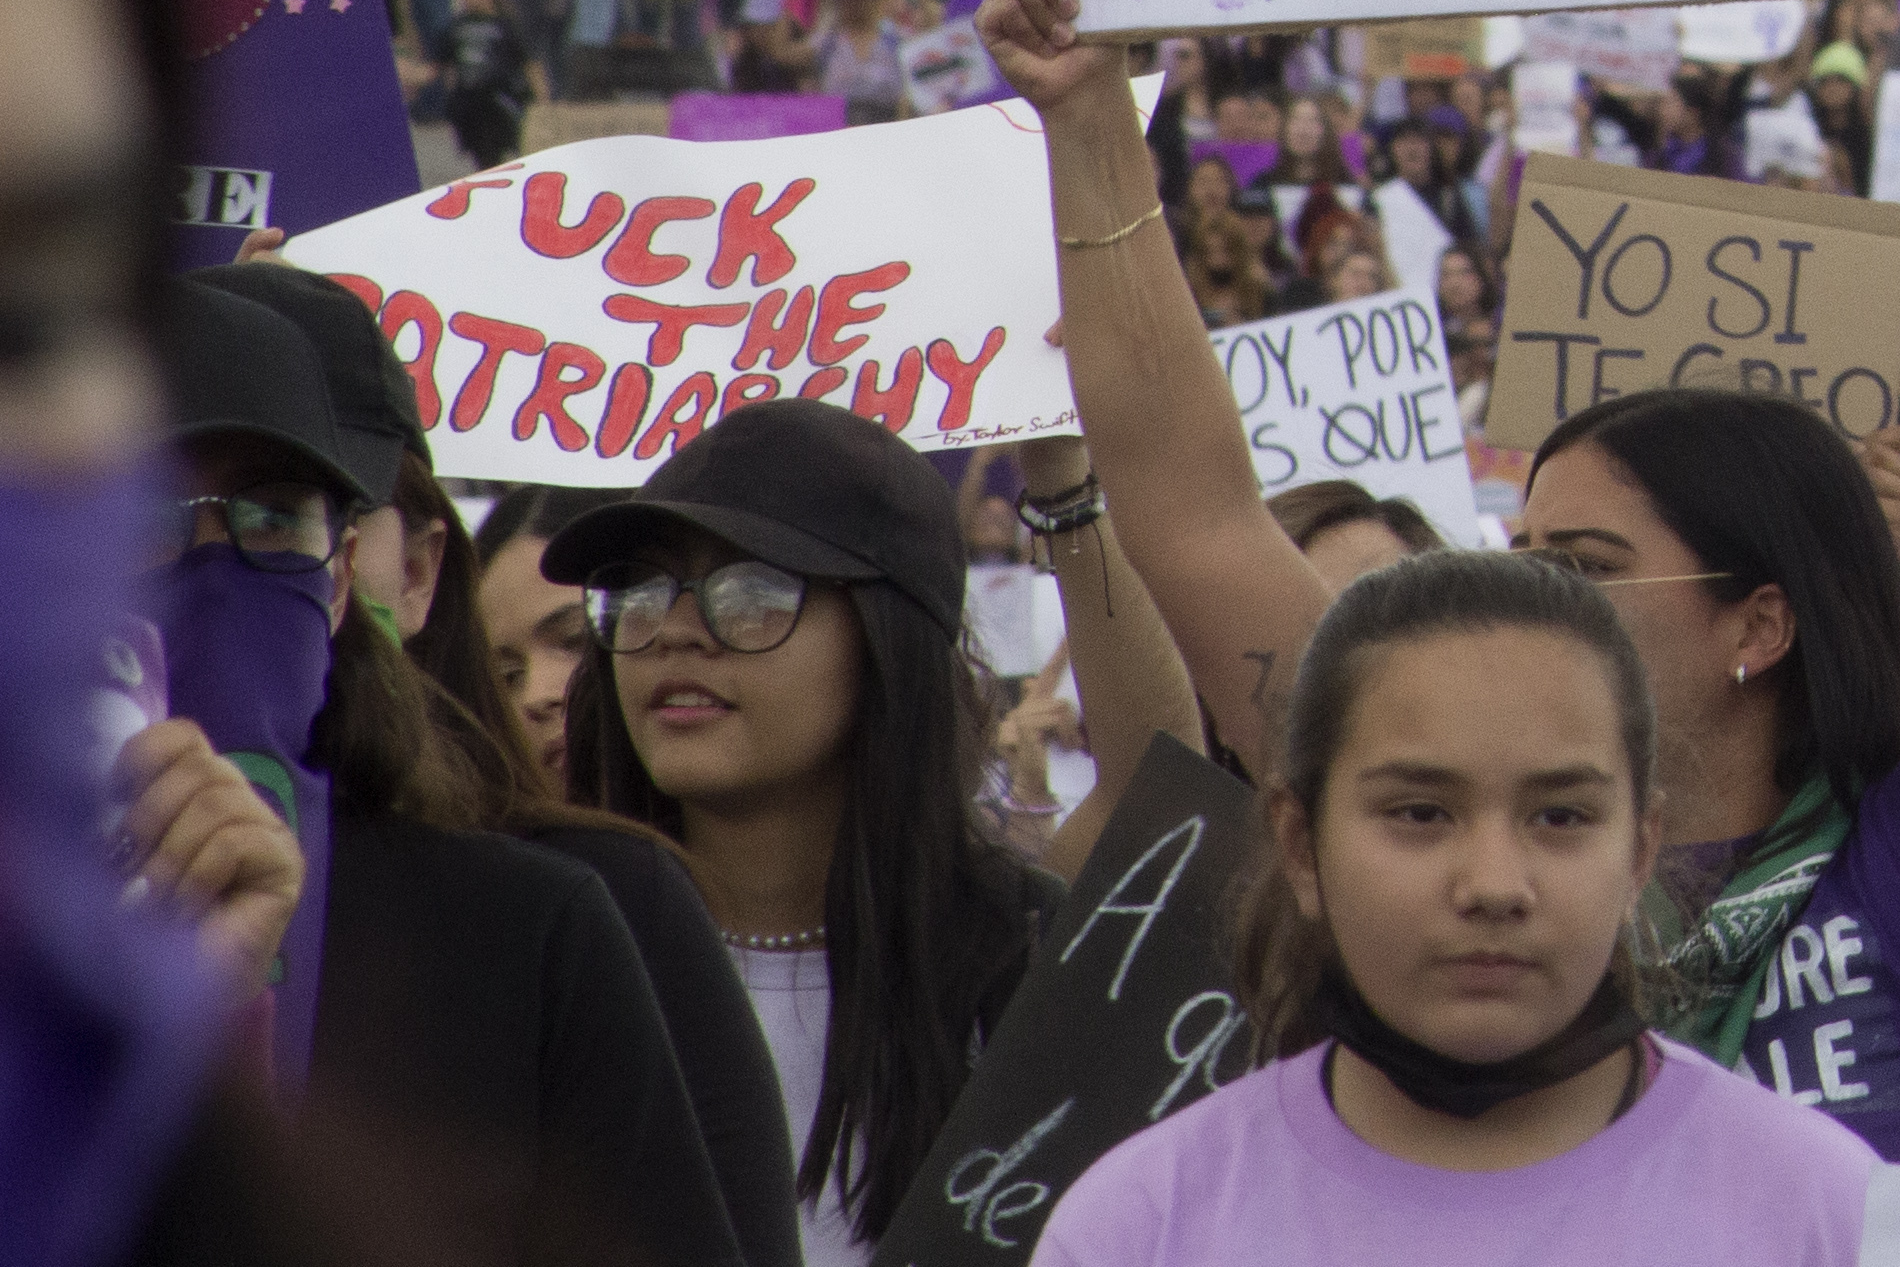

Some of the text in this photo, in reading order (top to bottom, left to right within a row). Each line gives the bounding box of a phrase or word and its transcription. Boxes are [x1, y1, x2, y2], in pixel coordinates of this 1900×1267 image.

[601, 260, 911, 371] THE
[1530, 199, 1817, 346] YO SI
[327, 272, 1005, 460] ATRIARHY
[1316, 299, 1438, 390] POR
[1511, 330, 1646, 422] TE
[1317, 383, 1464, 469] QUE
